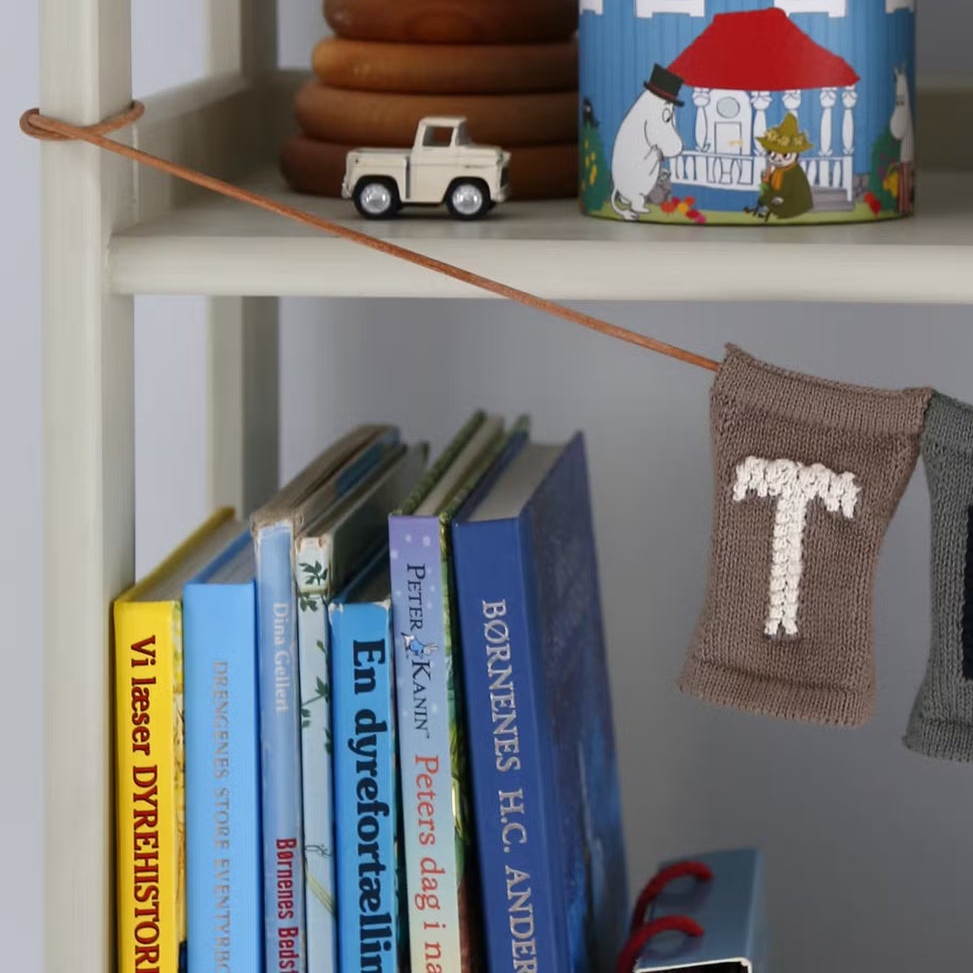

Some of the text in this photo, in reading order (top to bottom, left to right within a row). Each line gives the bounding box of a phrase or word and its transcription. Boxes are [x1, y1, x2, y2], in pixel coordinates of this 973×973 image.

[406, 563, 427, 631] PETER
[130, 635, 156, 667] Vi
[273, 603, 291, 713] Dina Gellert
[353, 640, 387, 696] En
[131, 677, 157, 756] læser
[213, 660, 231, 780] DRENGENES
[481, 600, 521, 772] BØRNENES
[214, 788, 231, 850] STORE
[415, 755, 440, 846] Peters
[498, 788, 527, 854] H.C.
[276, 838, 297, 920] Børnenes
[415, 857, 446, 911] dag
[424, 921, 448, 931] i
